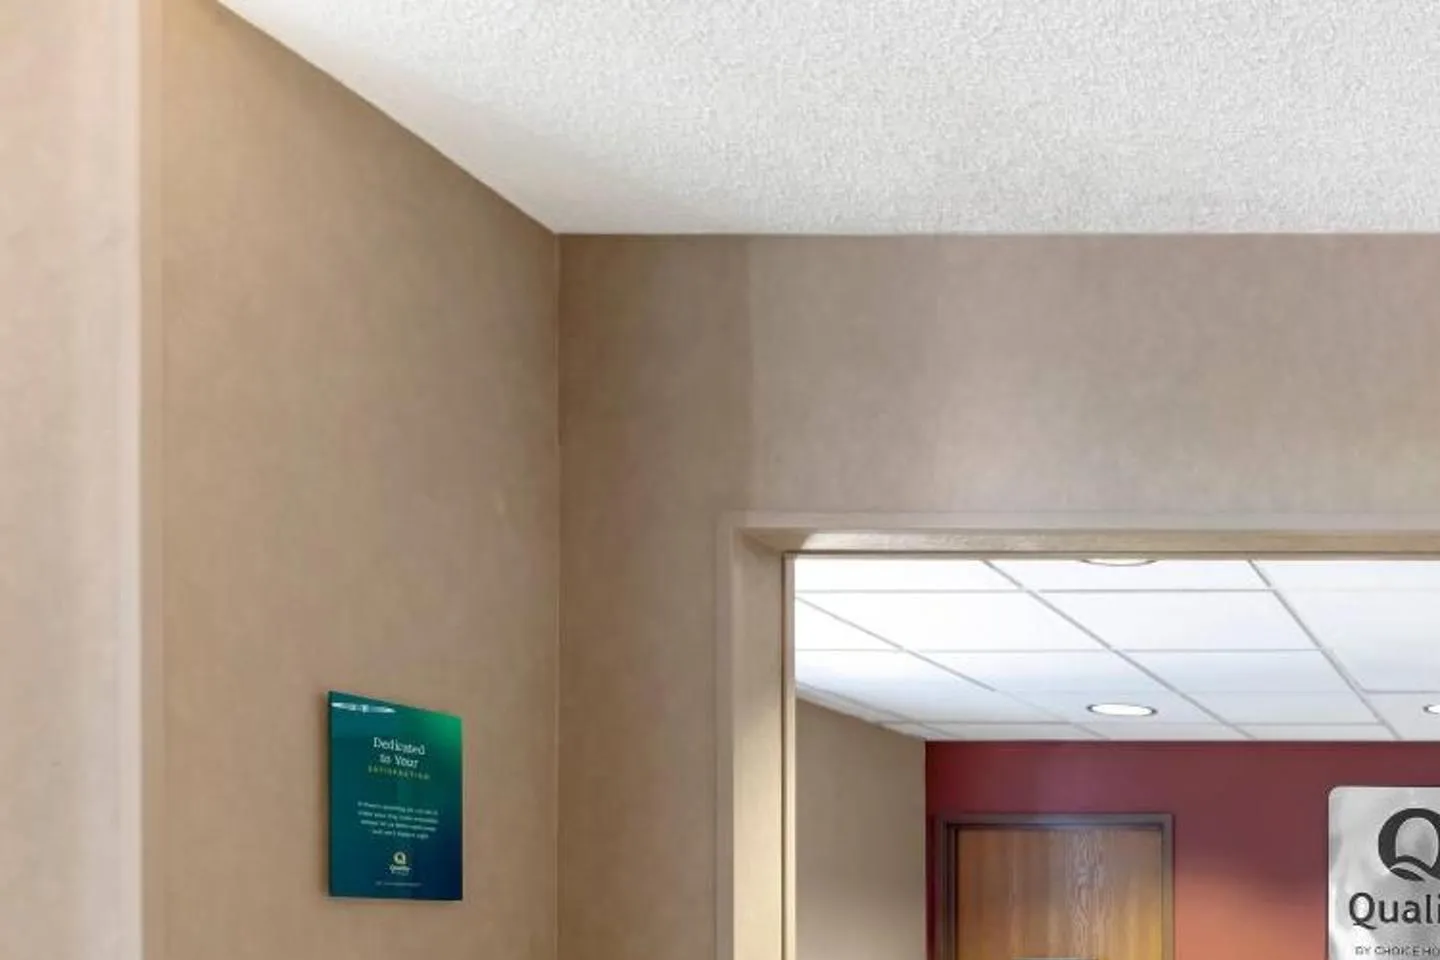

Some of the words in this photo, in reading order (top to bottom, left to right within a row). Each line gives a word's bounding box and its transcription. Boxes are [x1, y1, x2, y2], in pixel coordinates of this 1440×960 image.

[373, 736, 426, 755] Dedicated
[380, 754, 392, 764] to
[394, 755, 419, 769] Your
[1354, 946, 1371, 956] BY
[1374, 945, 1421, 957] CHOICE
